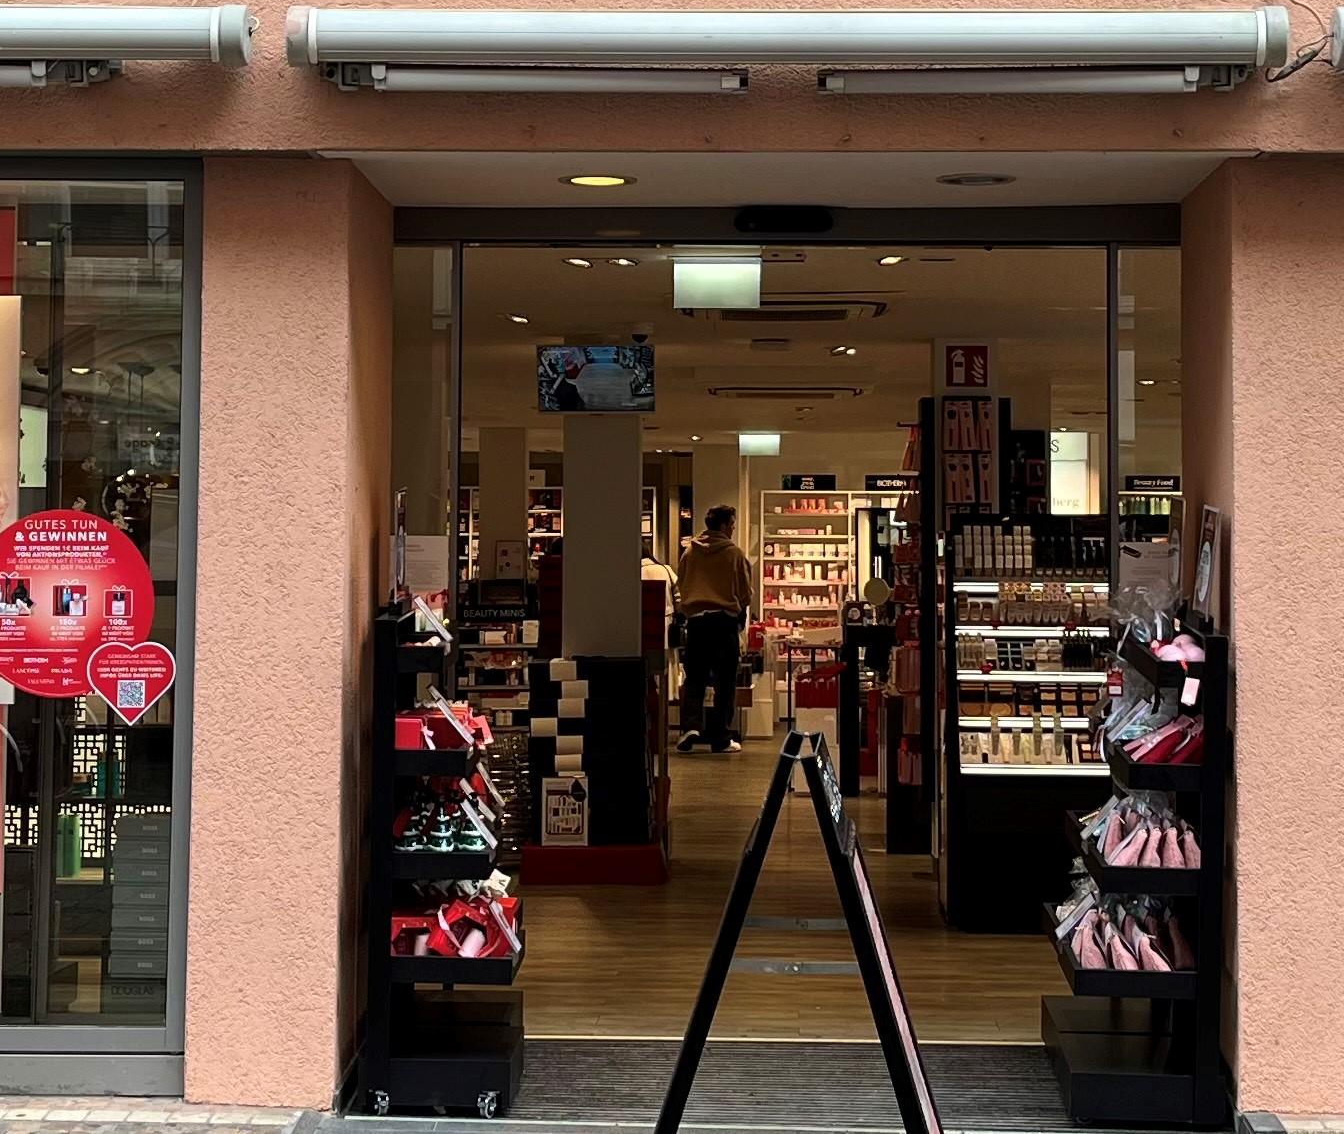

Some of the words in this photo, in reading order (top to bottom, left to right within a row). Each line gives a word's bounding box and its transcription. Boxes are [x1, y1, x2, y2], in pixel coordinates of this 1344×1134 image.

[24, 519, 66, 530] GUTES
[71, 519, 98, 530] TUN
[15, 531, 25, 542] &
[29, 531, 107, 542] GEWINNEN
